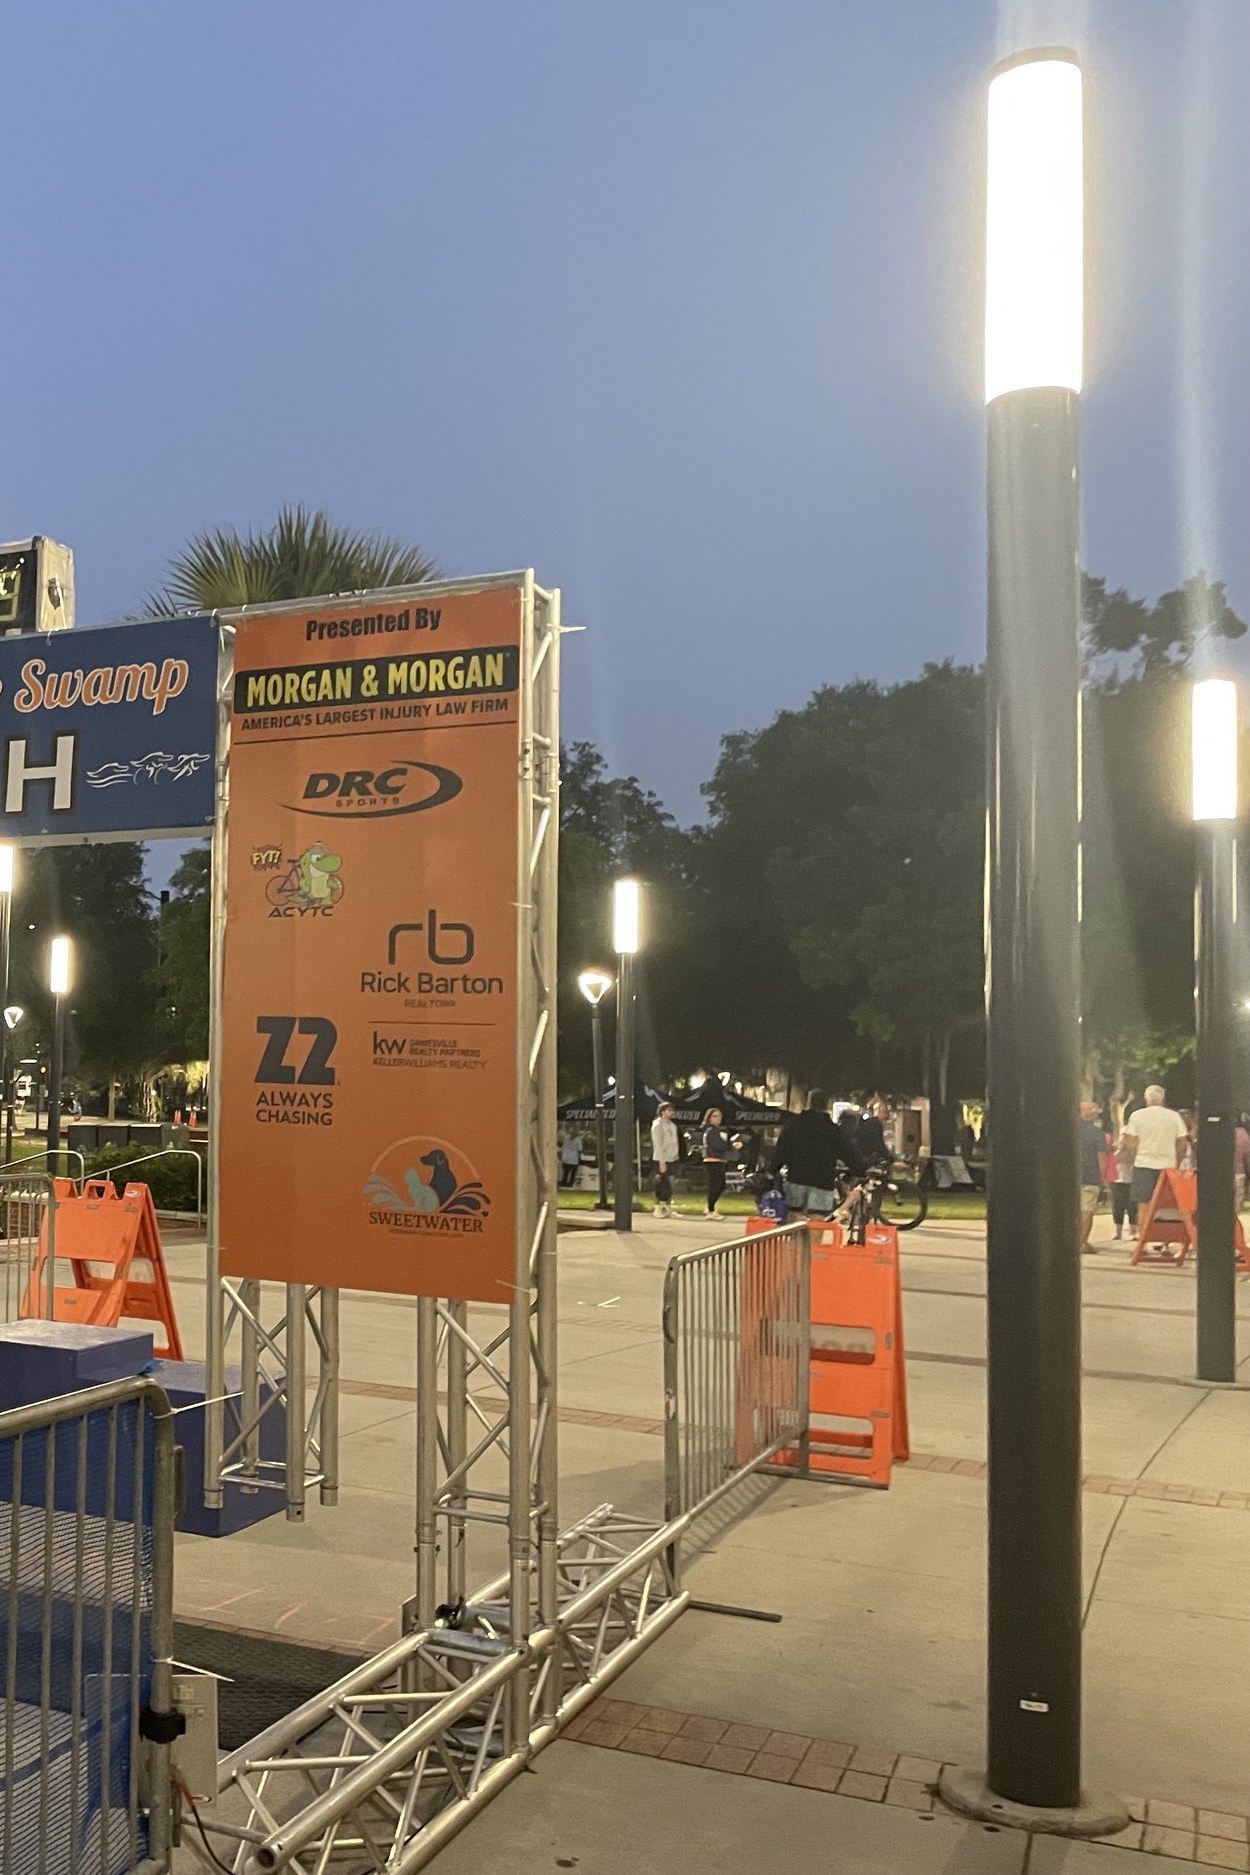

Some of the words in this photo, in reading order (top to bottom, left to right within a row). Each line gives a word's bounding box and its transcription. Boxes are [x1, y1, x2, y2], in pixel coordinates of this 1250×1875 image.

[305, 609, 411, 642] Presented
[414, 607, 442, 631] By
[12, 657, 190, 715] Swamp
[246, 666, 353, 708] MORGAN
[360, 664, 379, 698] &
[387, 653, 505, 695] MORGAN
[240, 712, 312, 732] AMERICA'S
[315, 708, 377, 726] LARGEST
[380, 704, 432, 721] INJURY
[436, 701, 468, 717] LAW
[471, 698, 509, 714] FIRM
[301, 767, 409, 800] DRC
[335, 797, 401, 808] SPORTS
[252, 850, 281, 865] FYT!
[268, 906, 335, 918] ACYTC
[387, 908, 475, 966] rb
[360, 972, 411, 994] Rick
[417, 972, 504, 995] Barton
[372, 1030, 407, 1055] kw
[256, 1090, 334, 1110] ALWAYS
[256, 1108, 333, 1126] CHASING
[368, 1211, 484, 1233] SWEETWATER
